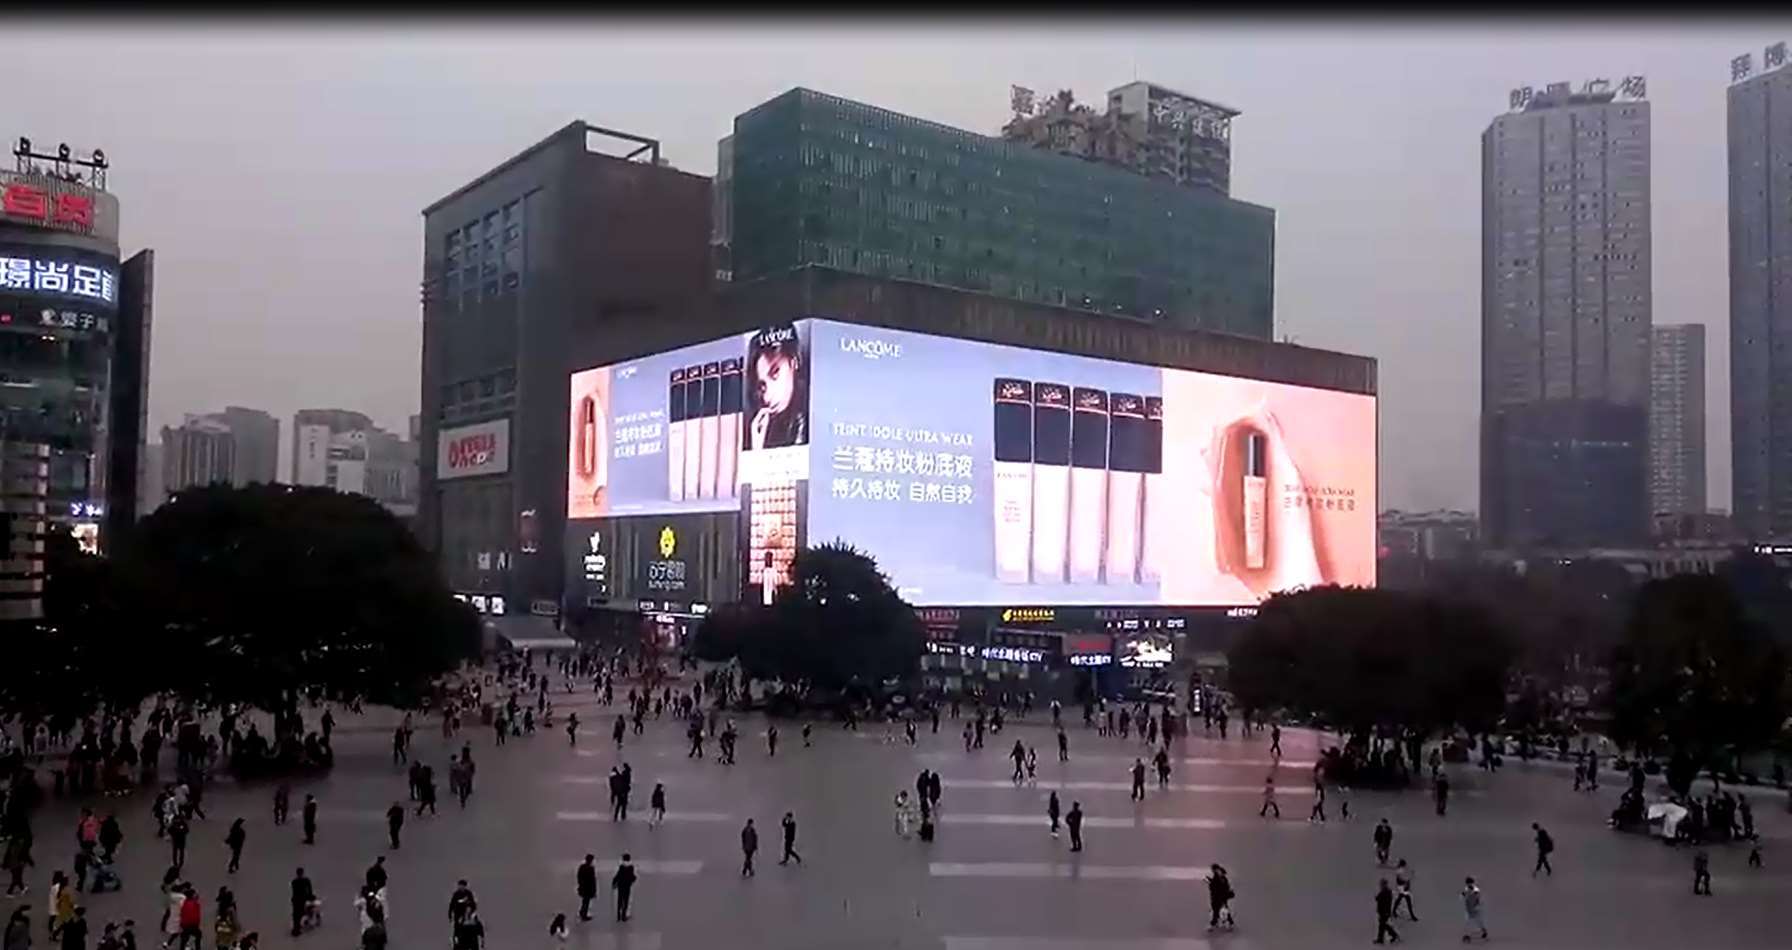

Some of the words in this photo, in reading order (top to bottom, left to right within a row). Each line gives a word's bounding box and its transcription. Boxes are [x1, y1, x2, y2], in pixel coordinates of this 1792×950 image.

[1510, 76, 1646, 110] 朗广场
[942, 432, 973, 446] WEAR
[832, 446, 973, 478] 兰蔻持妆粉底液
[910, 482, 973, 504] 自然自我
